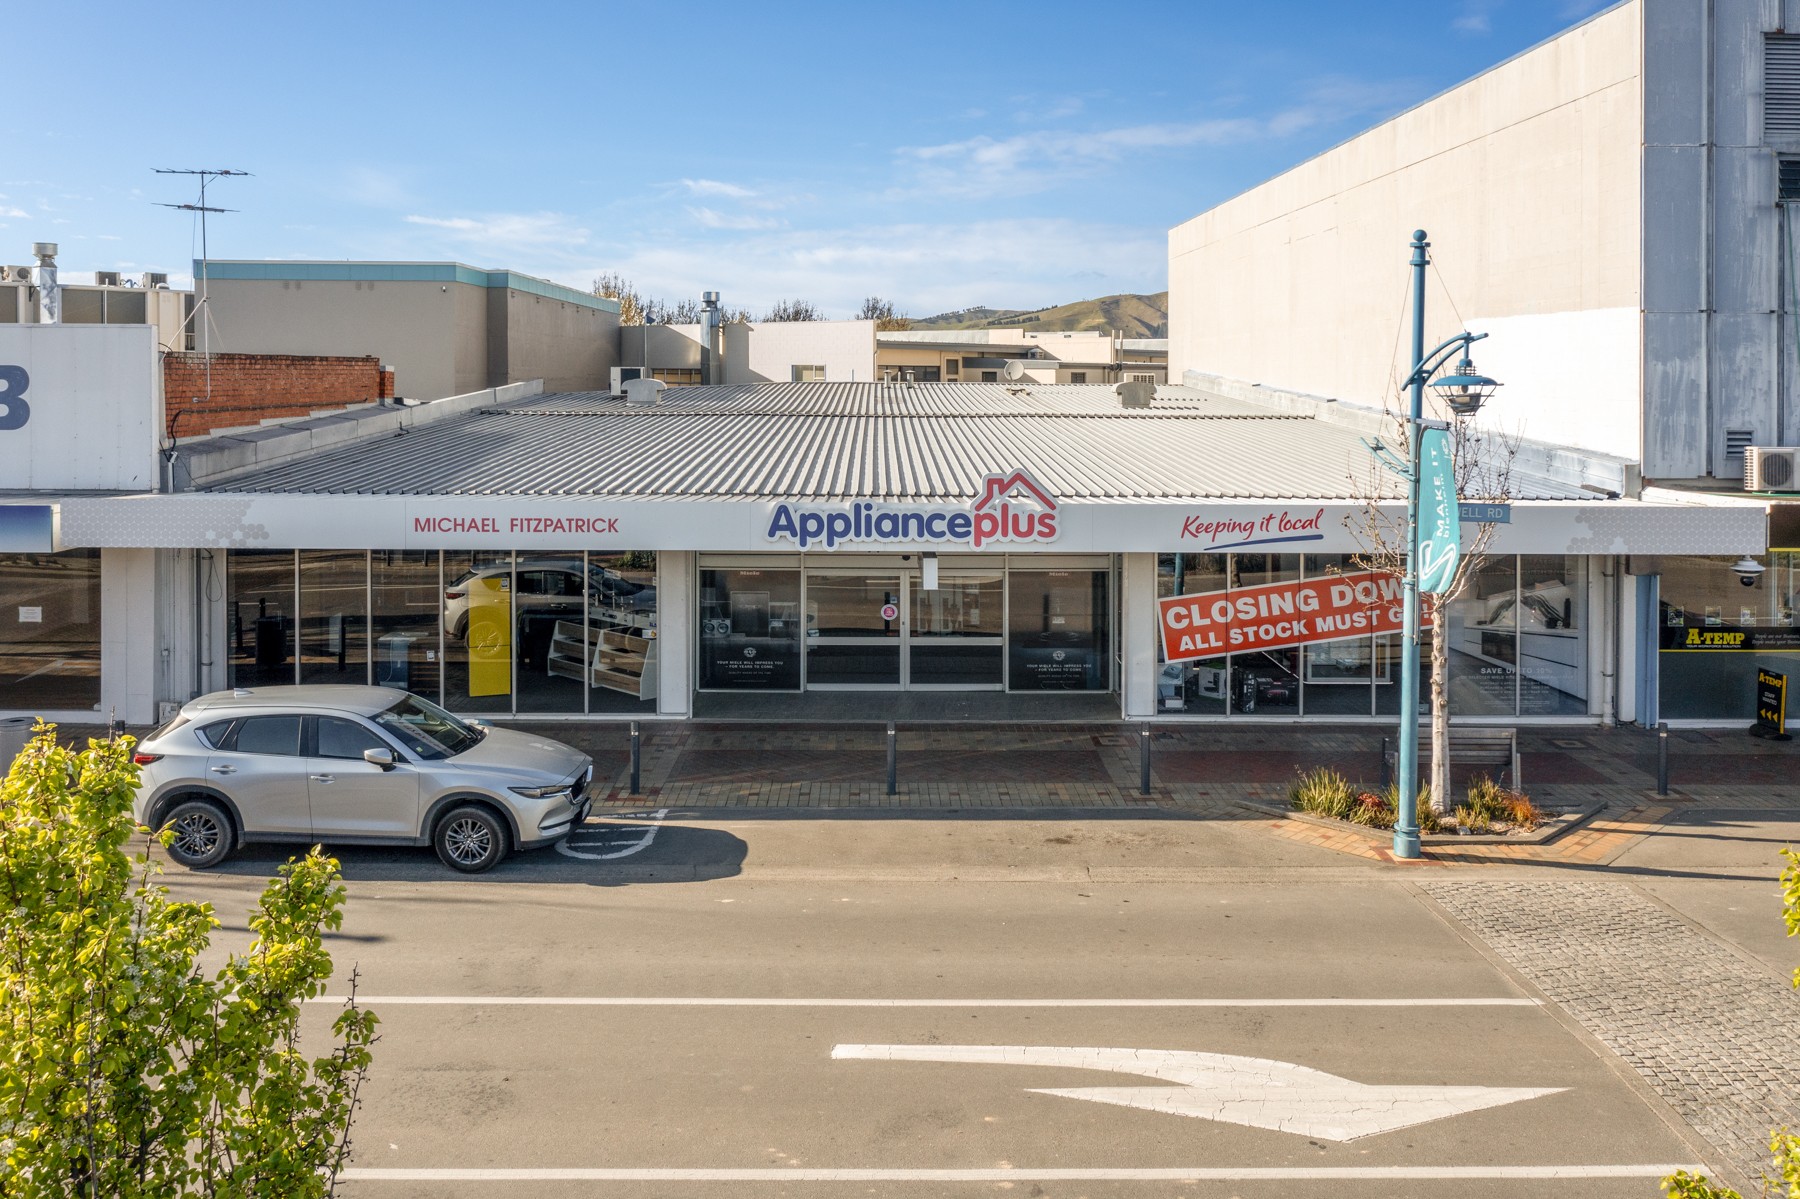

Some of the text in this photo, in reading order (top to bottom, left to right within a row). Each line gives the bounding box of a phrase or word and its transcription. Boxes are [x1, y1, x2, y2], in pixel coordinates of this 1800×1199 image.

[1430, 447, 1445, 538] MAKE IT
[414, 517, 619, 533] MICHAEL FITZPATRICK
[1180, 507, 1325, 542] Keeping it local
[1459, 507, 1503, 518] ELL RD
[1166, 578, 1404, 630] CLOSING DOW
[1179, 603, 1430, 651] ALL STOCK MUST G!
[1686, 628, 1745, 644] A-TEMP
[1759, 672, 1783, 688] A-TEMP
